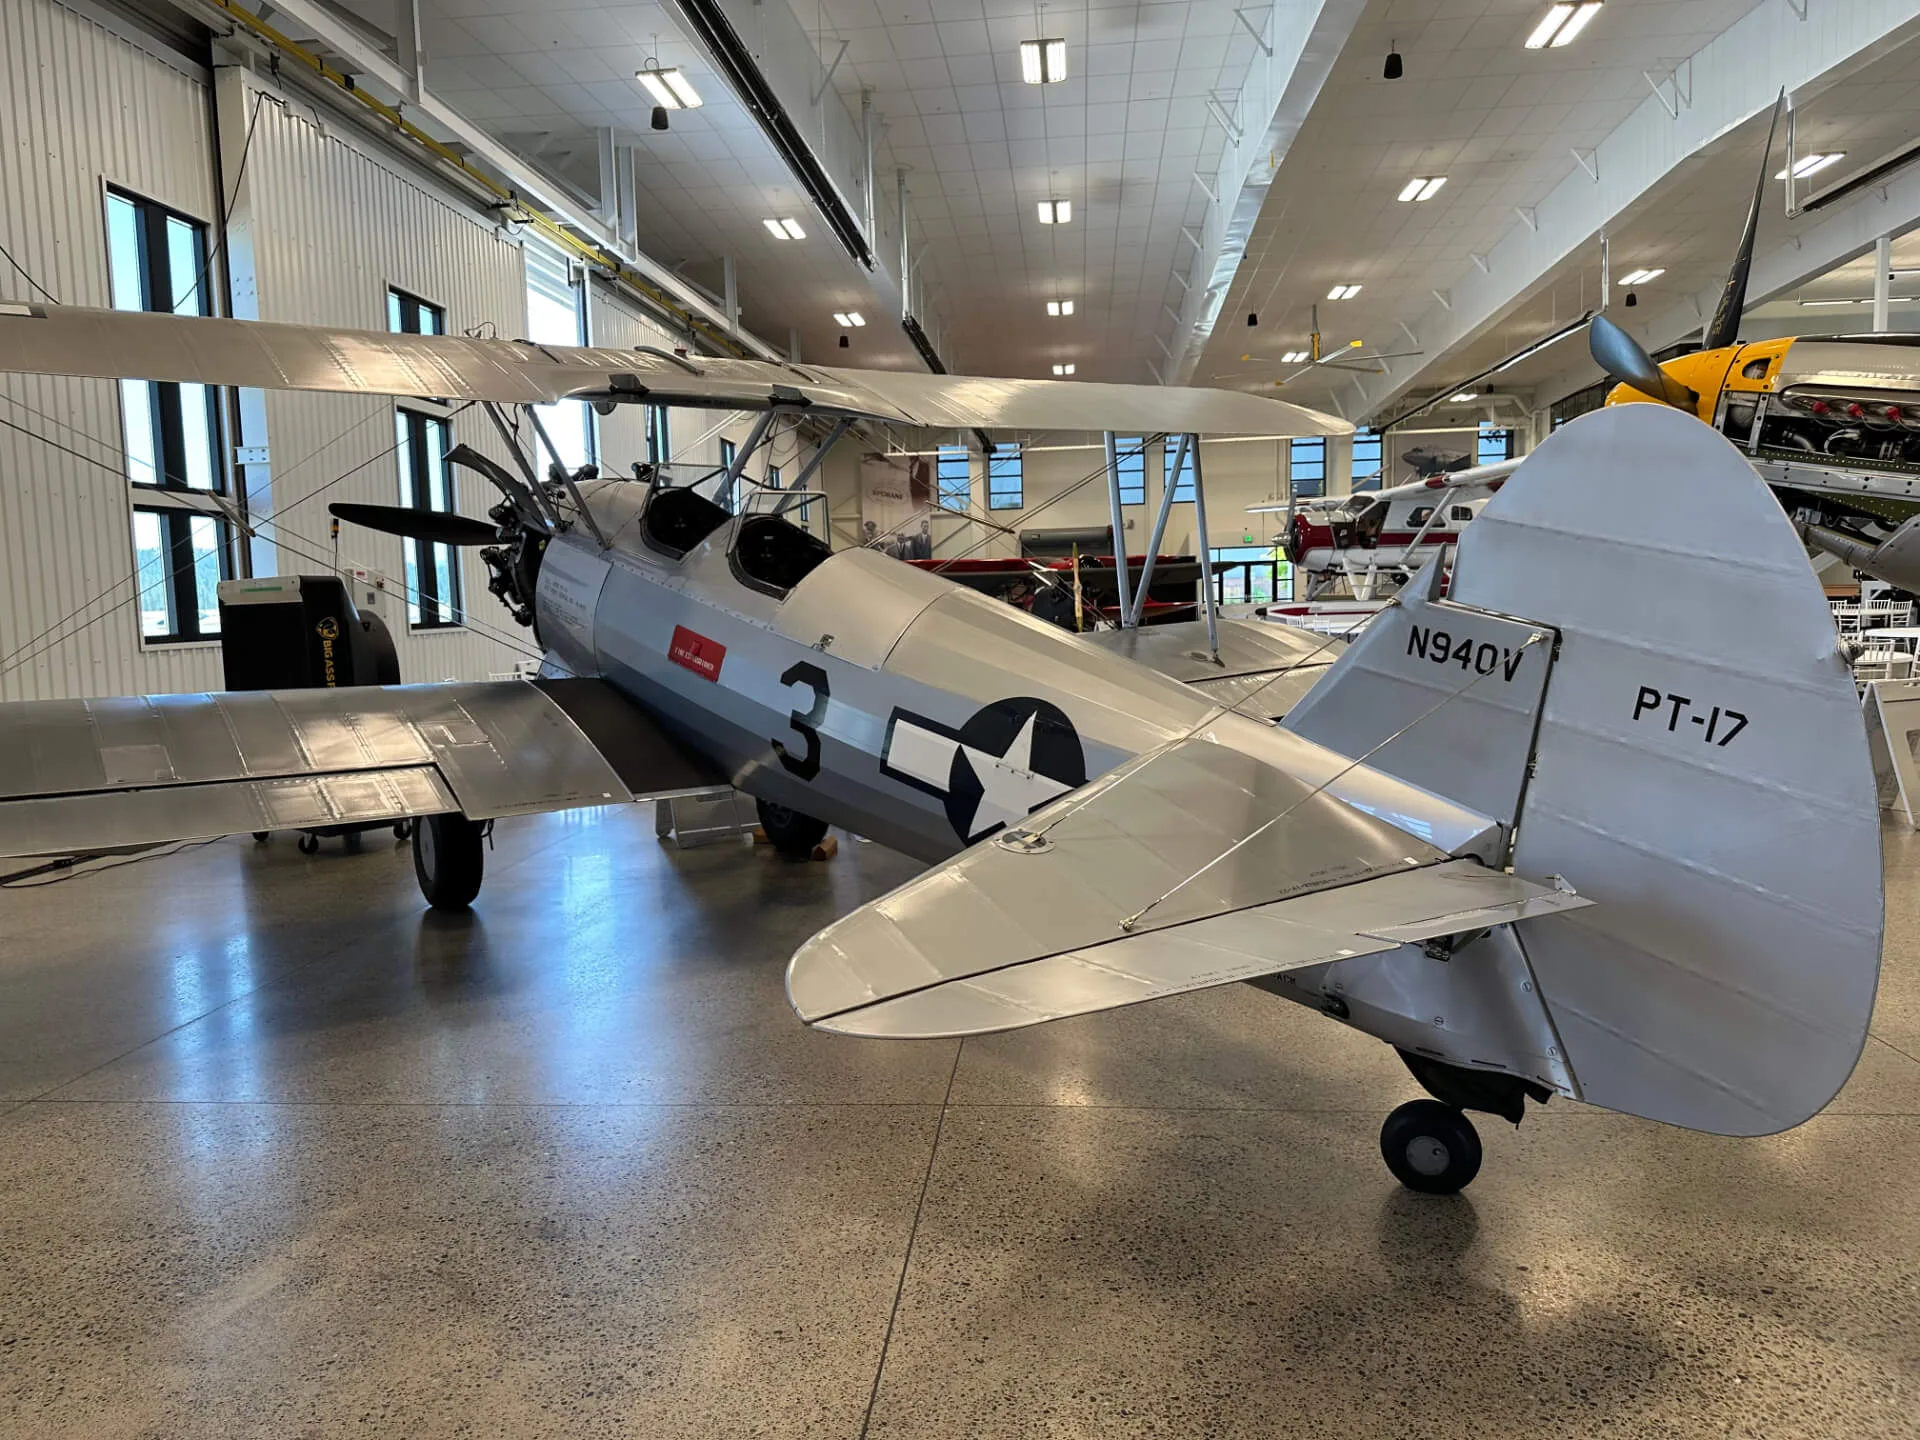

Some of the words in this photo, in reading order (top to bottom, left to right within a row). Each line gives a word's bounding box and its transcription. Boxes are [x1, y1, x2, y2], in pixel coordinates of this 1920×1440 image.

[323, 640, 333, 658] BIG
[324, 660, 335, 681] ASS
[1407, 625, 1524, 682] N940V
[771, 660, 831, 782] 3
[1632, 686, 1749, 747] PT-17
